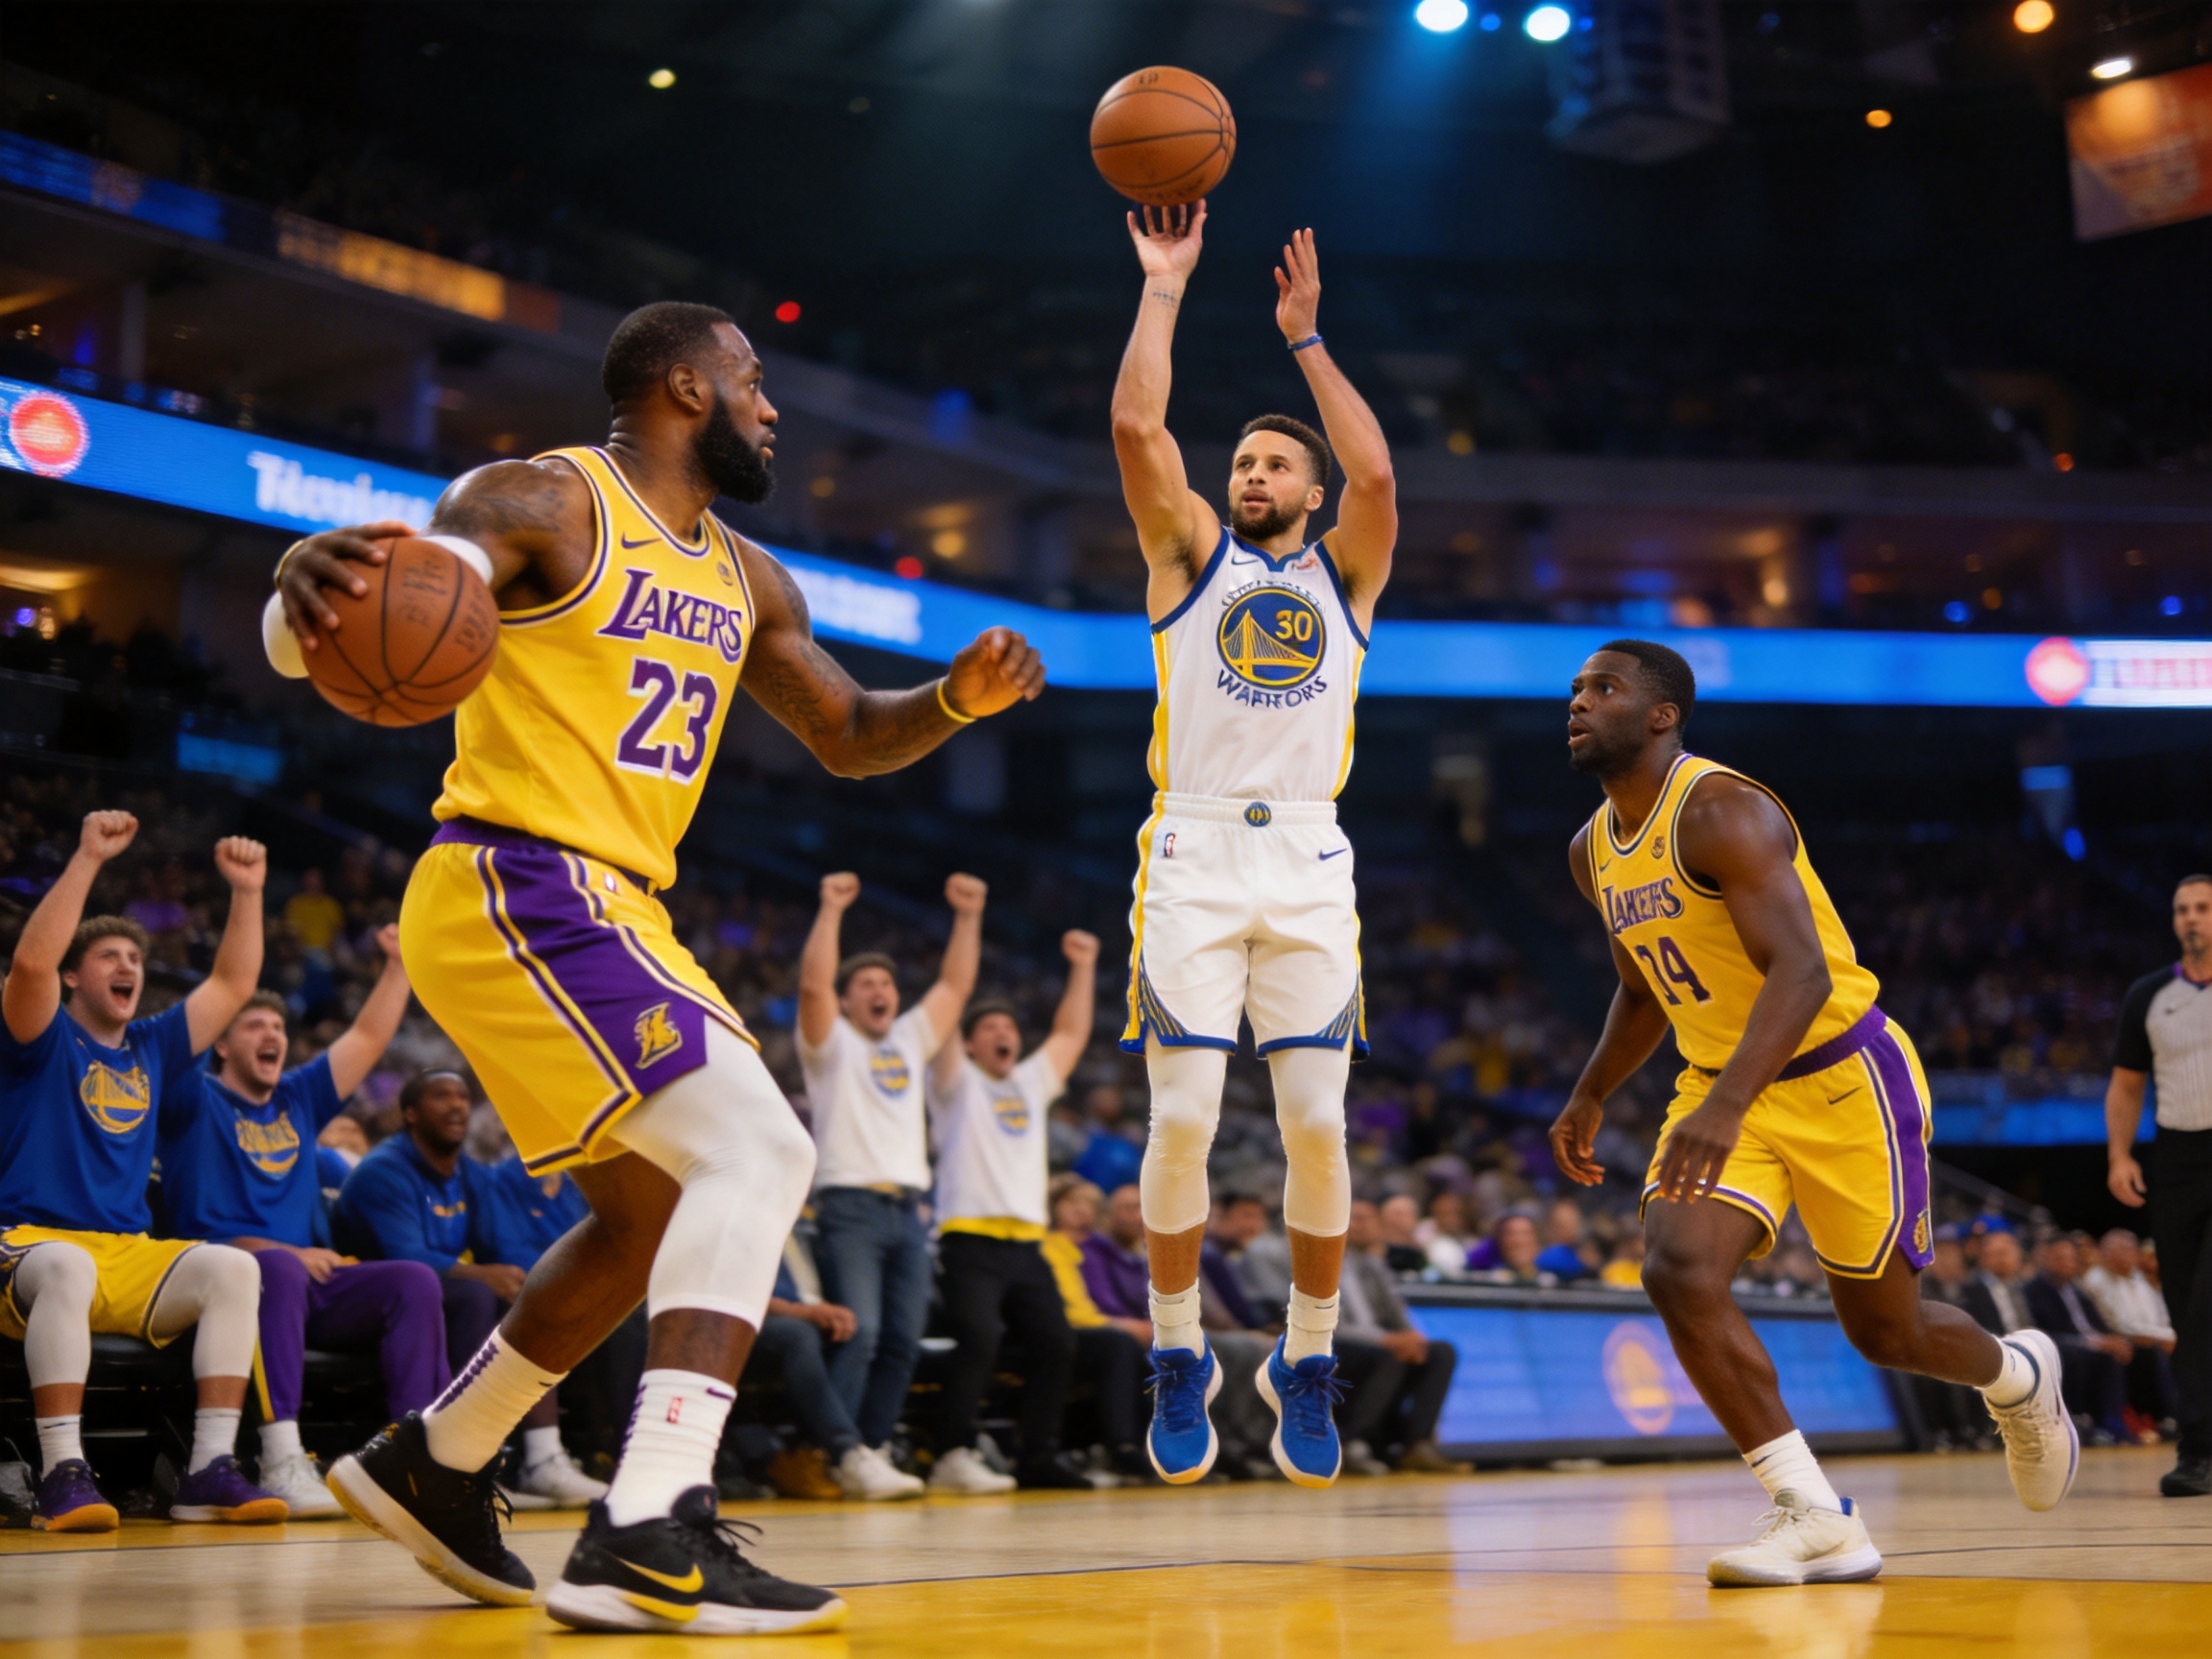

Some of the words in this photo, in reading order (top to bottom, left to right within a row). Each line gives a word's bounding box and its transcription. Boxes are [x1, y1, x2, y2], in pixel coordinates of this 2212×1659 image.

[595, 568, 742, 663] LAKERS
[1275, 610, 1313, 641] 30
[615, 656, 718, 785] 23
